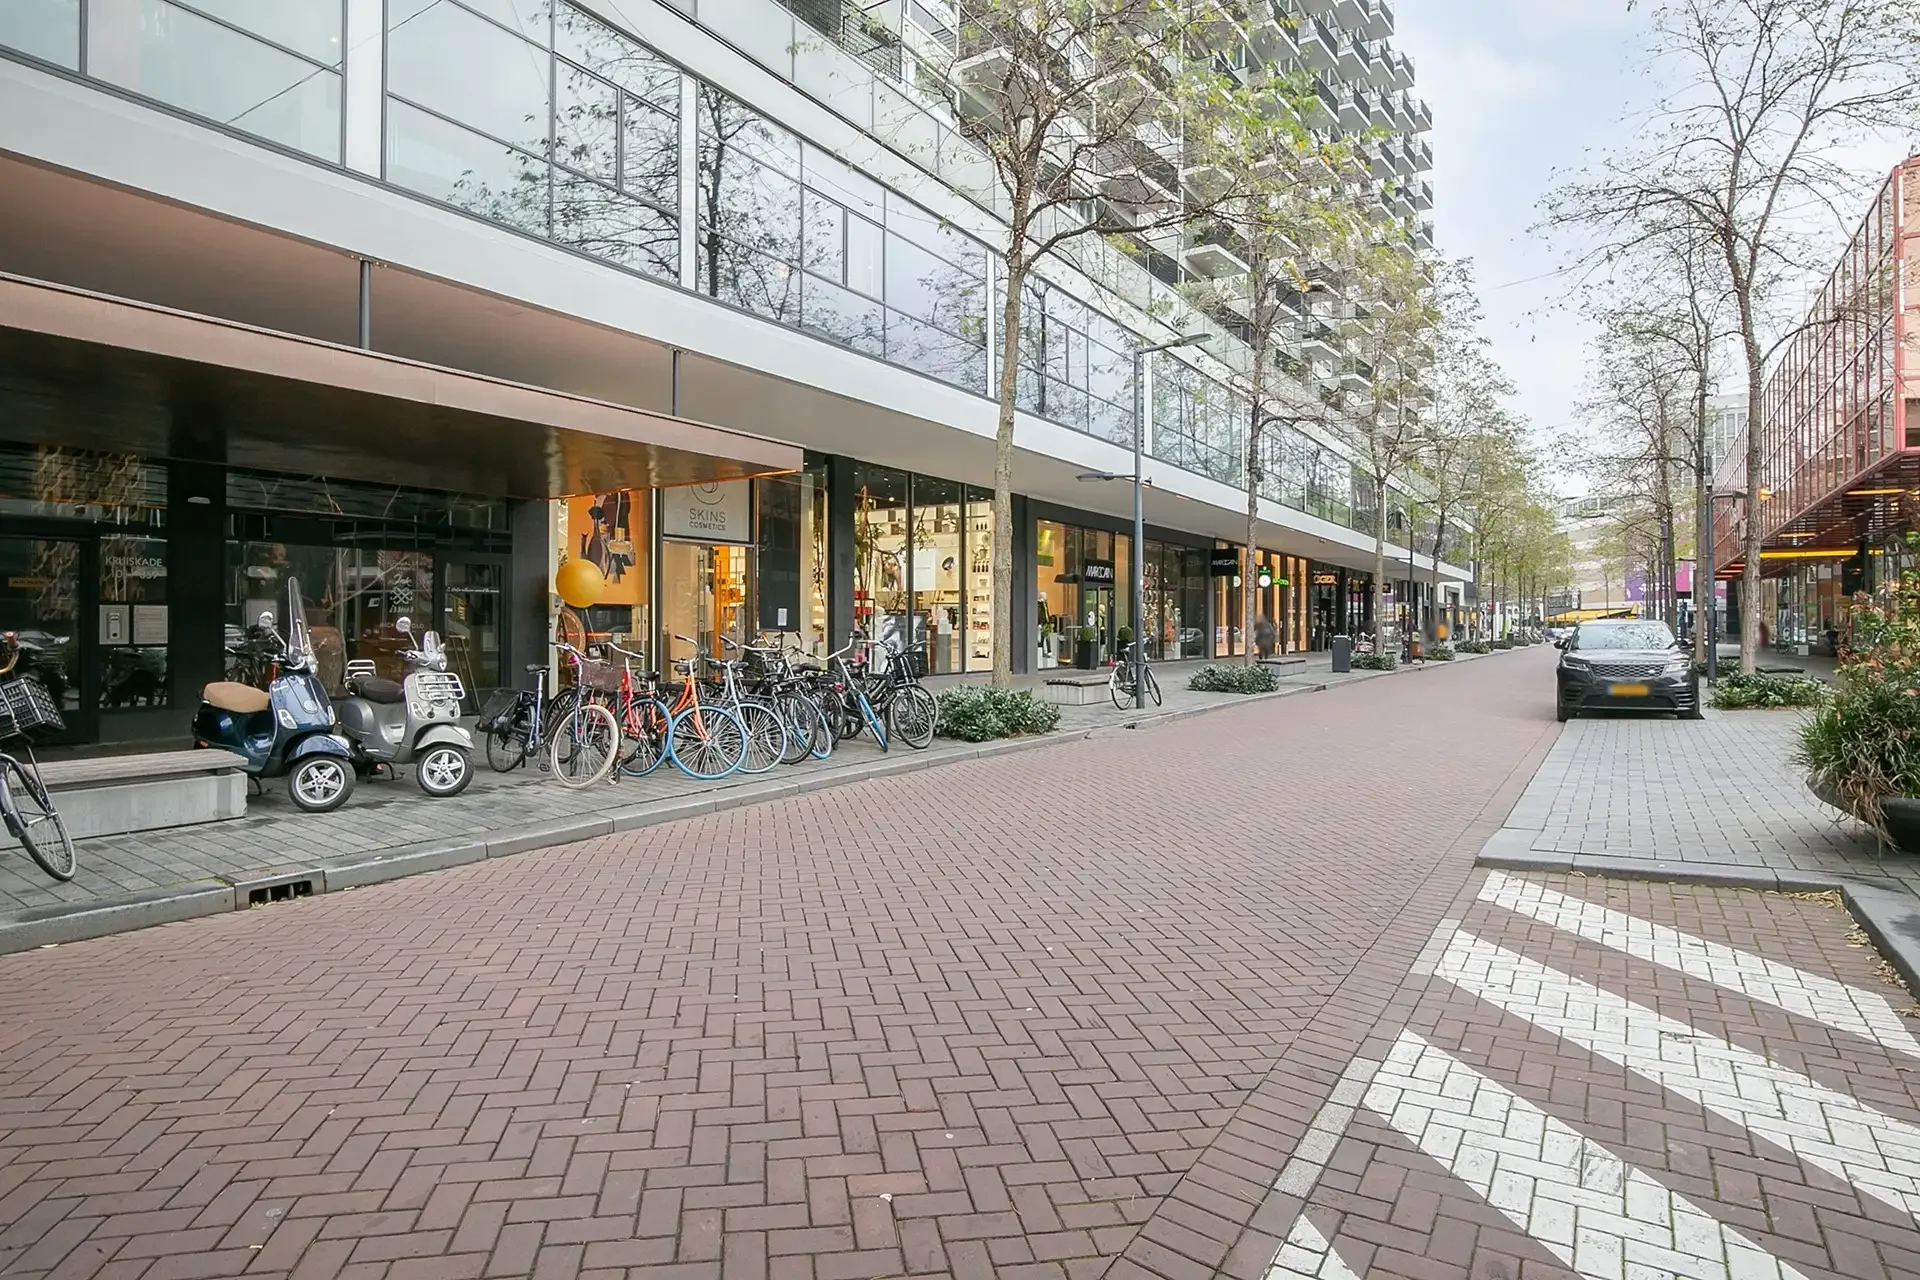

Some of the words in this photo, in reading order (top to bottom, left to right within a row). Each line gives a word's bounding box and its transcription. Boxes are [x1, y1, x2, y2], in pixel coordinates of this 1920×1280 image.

[689, 508, 726, 523] SKINS
[689, 521, 726, 531] COSMETICS
[105, 556, 163, 567] KRUISKADE
